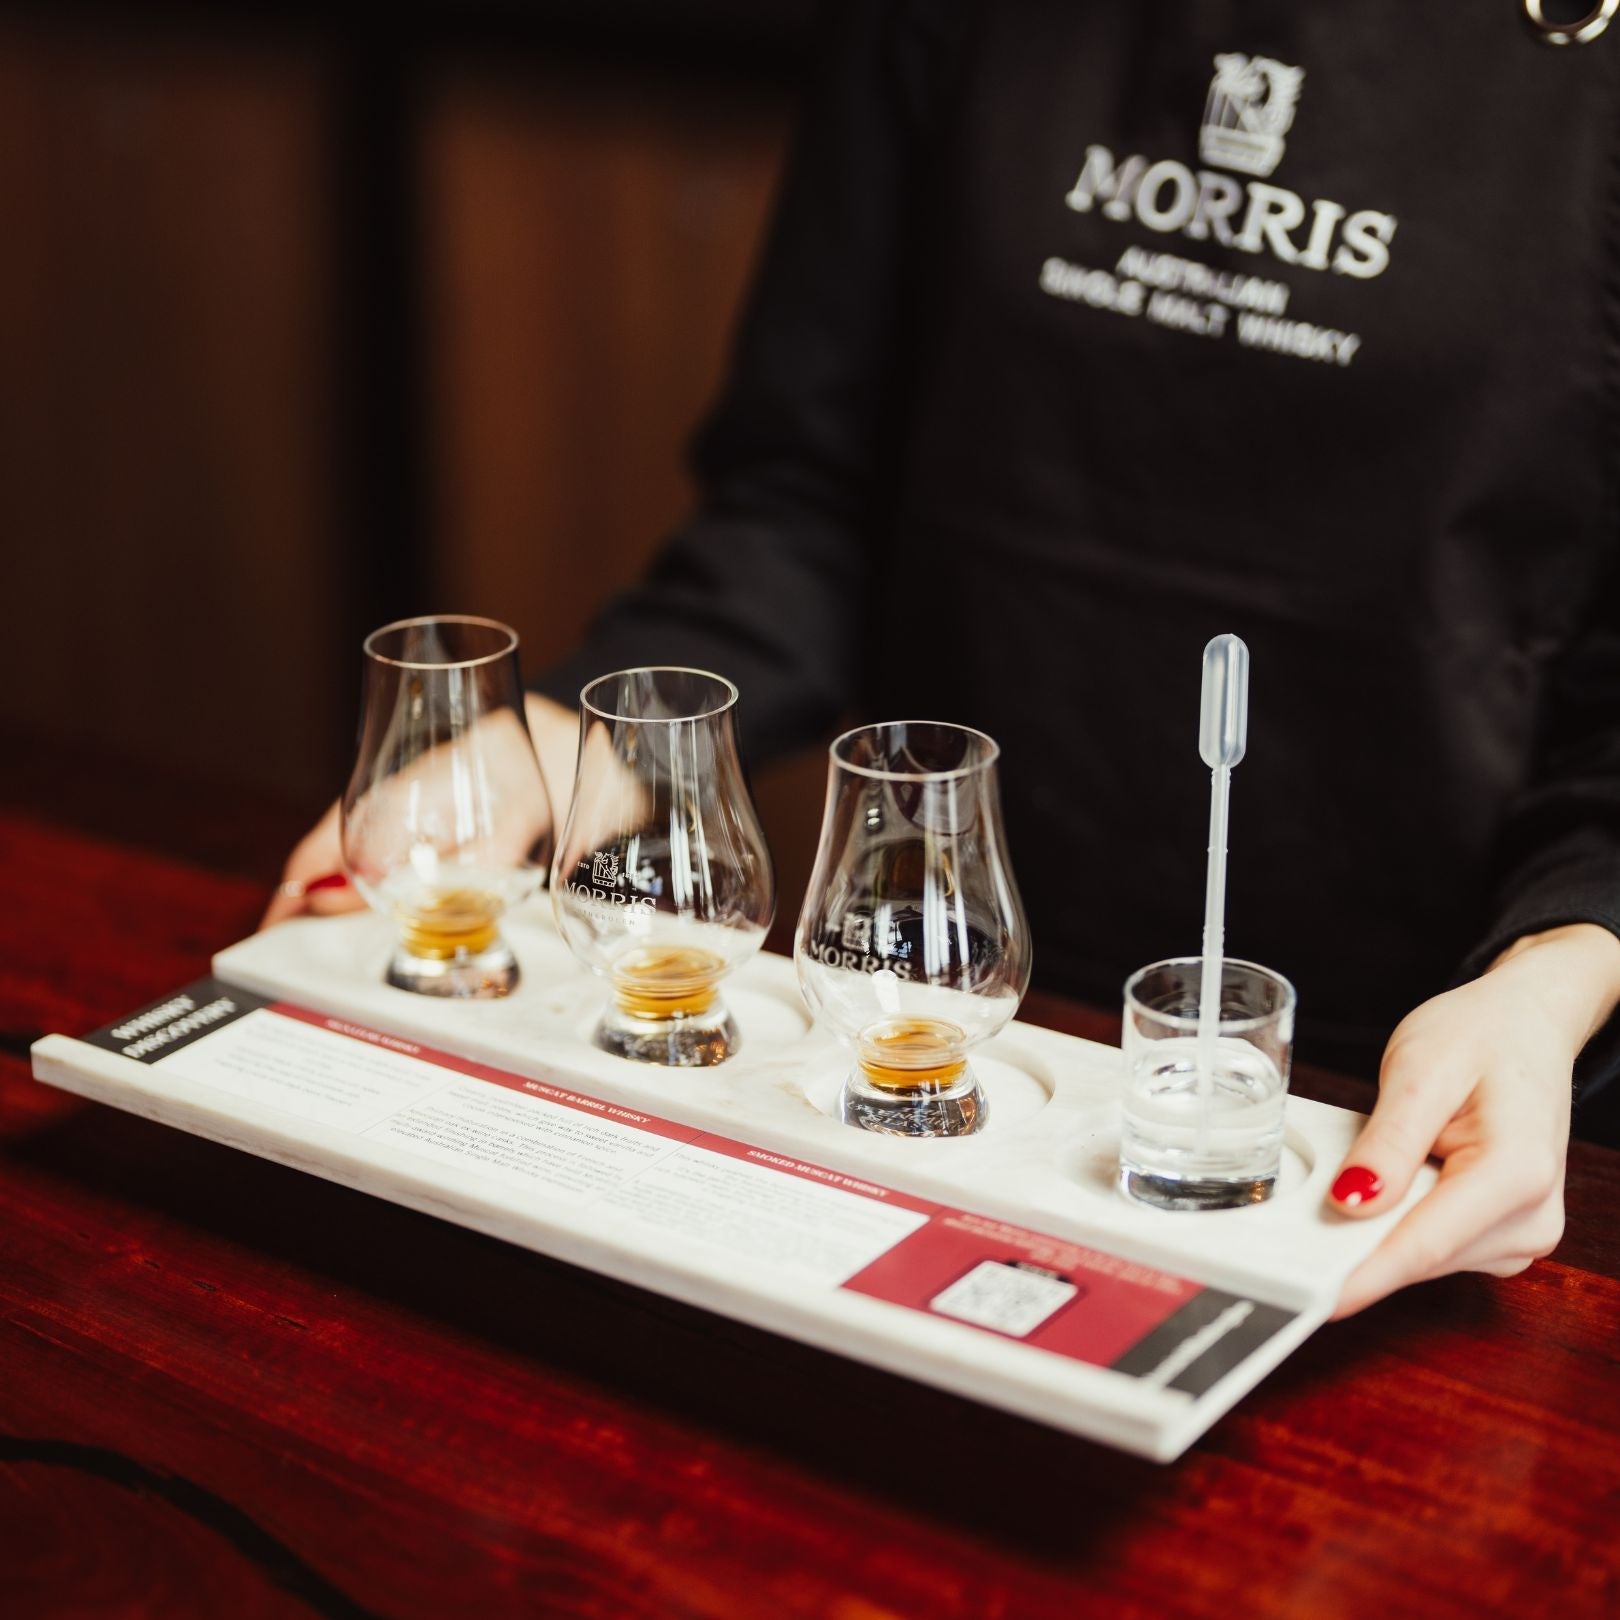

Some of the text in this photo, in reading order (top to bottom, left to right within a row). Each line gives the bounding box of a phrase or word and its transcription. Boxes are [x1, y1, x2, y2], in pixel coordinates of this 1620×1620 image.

[1065, 145, 1398, 278] MORRIS
[1116, 246, 1290, 316] AUSTRALIAN
[1146, 290, 1231, 338] MALT
[1237, 312, 1361, 366] WHISKY
[562, 878, 656, 915] MORRIS
[811, 940, 913, 980] MORRIS
[522, 1081, 568, 1099] MUSCAT
[566, 1094, 606, 1111] BARREL
[606, 1107, 651, 1123] WHISKY
[747, 1150, 795, 1168] SMOKED
[794, 1164, 843, 1183] MUSCAT
